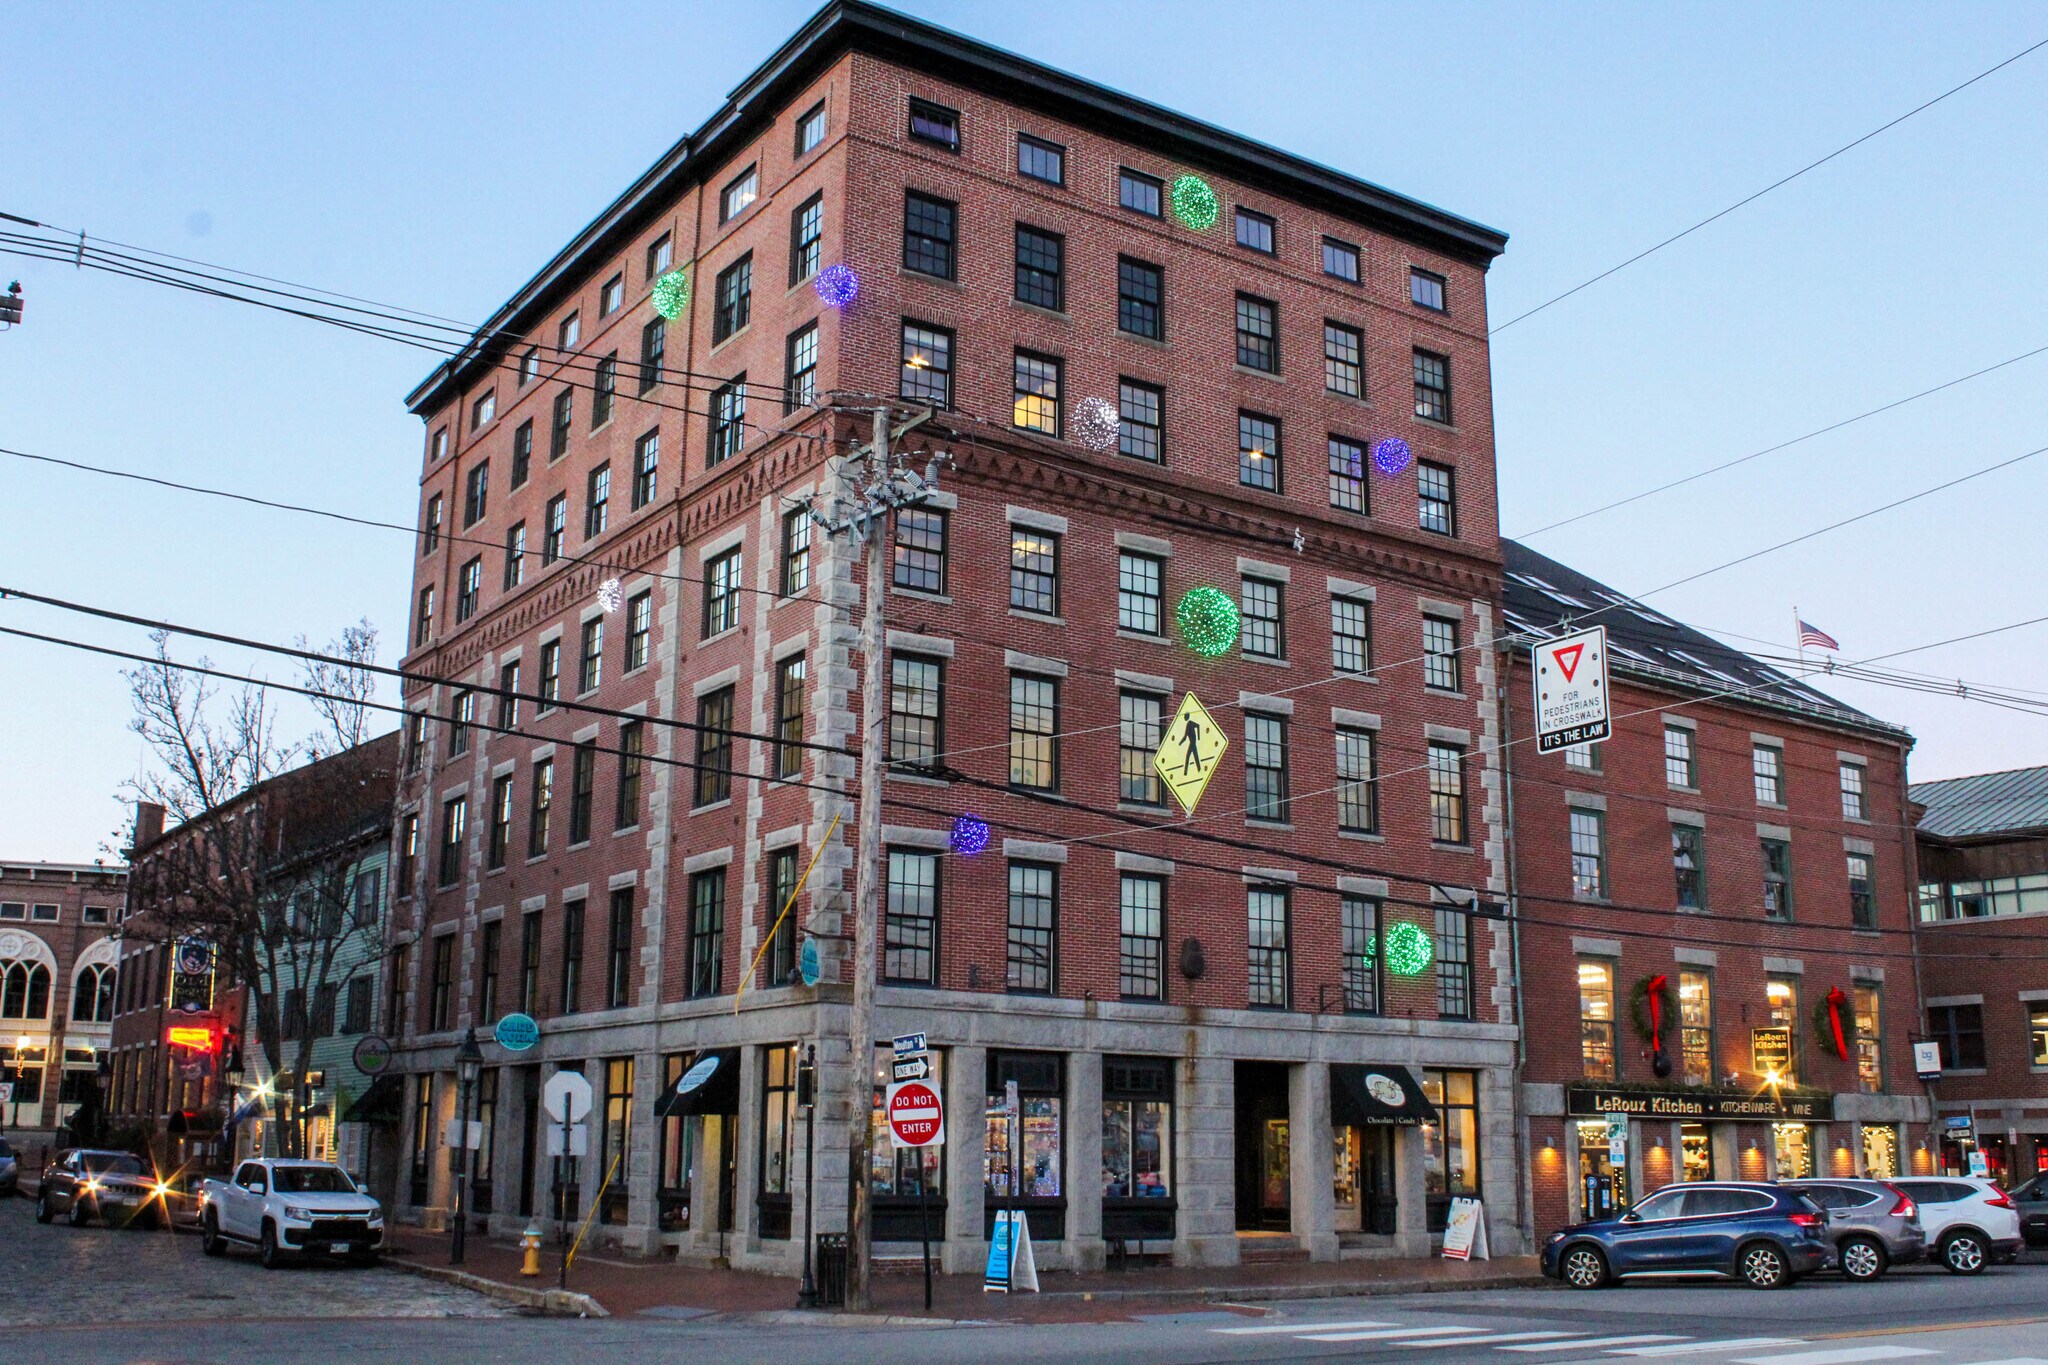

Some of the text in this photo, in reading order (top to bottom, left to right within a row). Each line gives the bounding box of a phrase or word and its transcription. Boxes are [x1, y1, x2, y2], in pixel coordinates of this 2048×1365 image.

[1563, 690, 1579, 702] FOR
[1544, 697, 1600, 718] PEDESTRIANS
[1542, 707, 1603, 730] IN CROSSWALK
[1563, 729, 1581, 743] THE
[894, 1039, 914, 1051] Moulton
[896, 1063, 920, 1077] ONE WAY
[896, 1095, 933, 1107] DO NOT
[1595, 1095, 1812, 1115] LeRoux Kitchen KITCHENWARE WINE
[1367, 1116, 1394, 1124] Chocolate
[1398, 1116, 1416, 1125] Candy
[902, 1122, 932, 1134] ENTER
